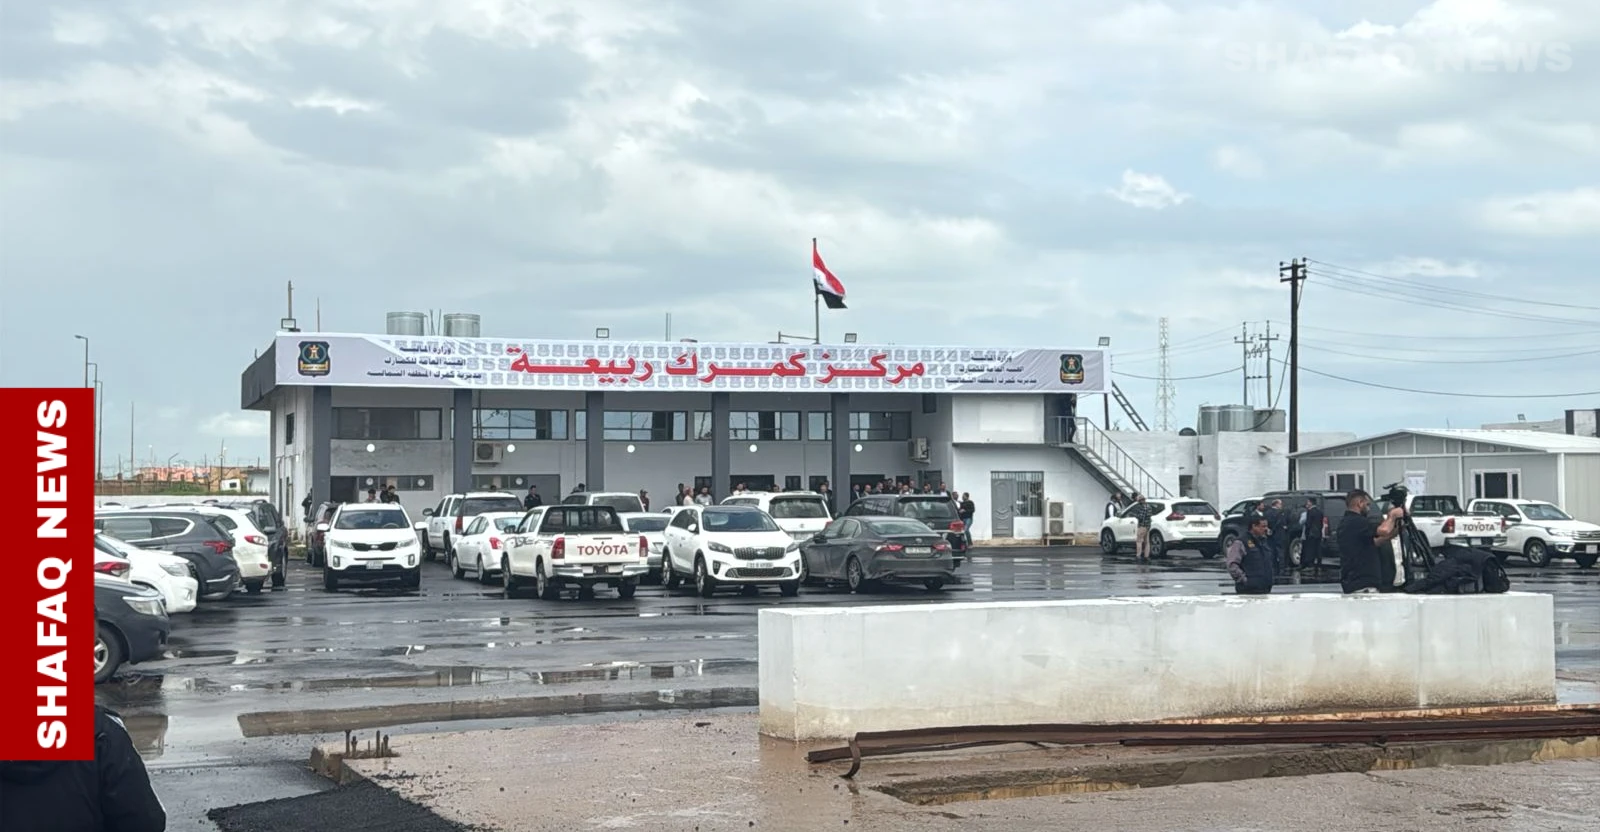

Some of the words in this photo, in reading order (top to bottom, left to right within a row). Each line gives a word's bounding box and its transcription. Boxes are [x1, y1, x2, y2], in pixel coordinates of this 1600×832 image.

[507, 346, 654, 384] ربيعة
[665, 352, 807, 383] كمرك
[816, 352, 925, 384] مركز
[577, 545, 628, 555] TOYOTA
